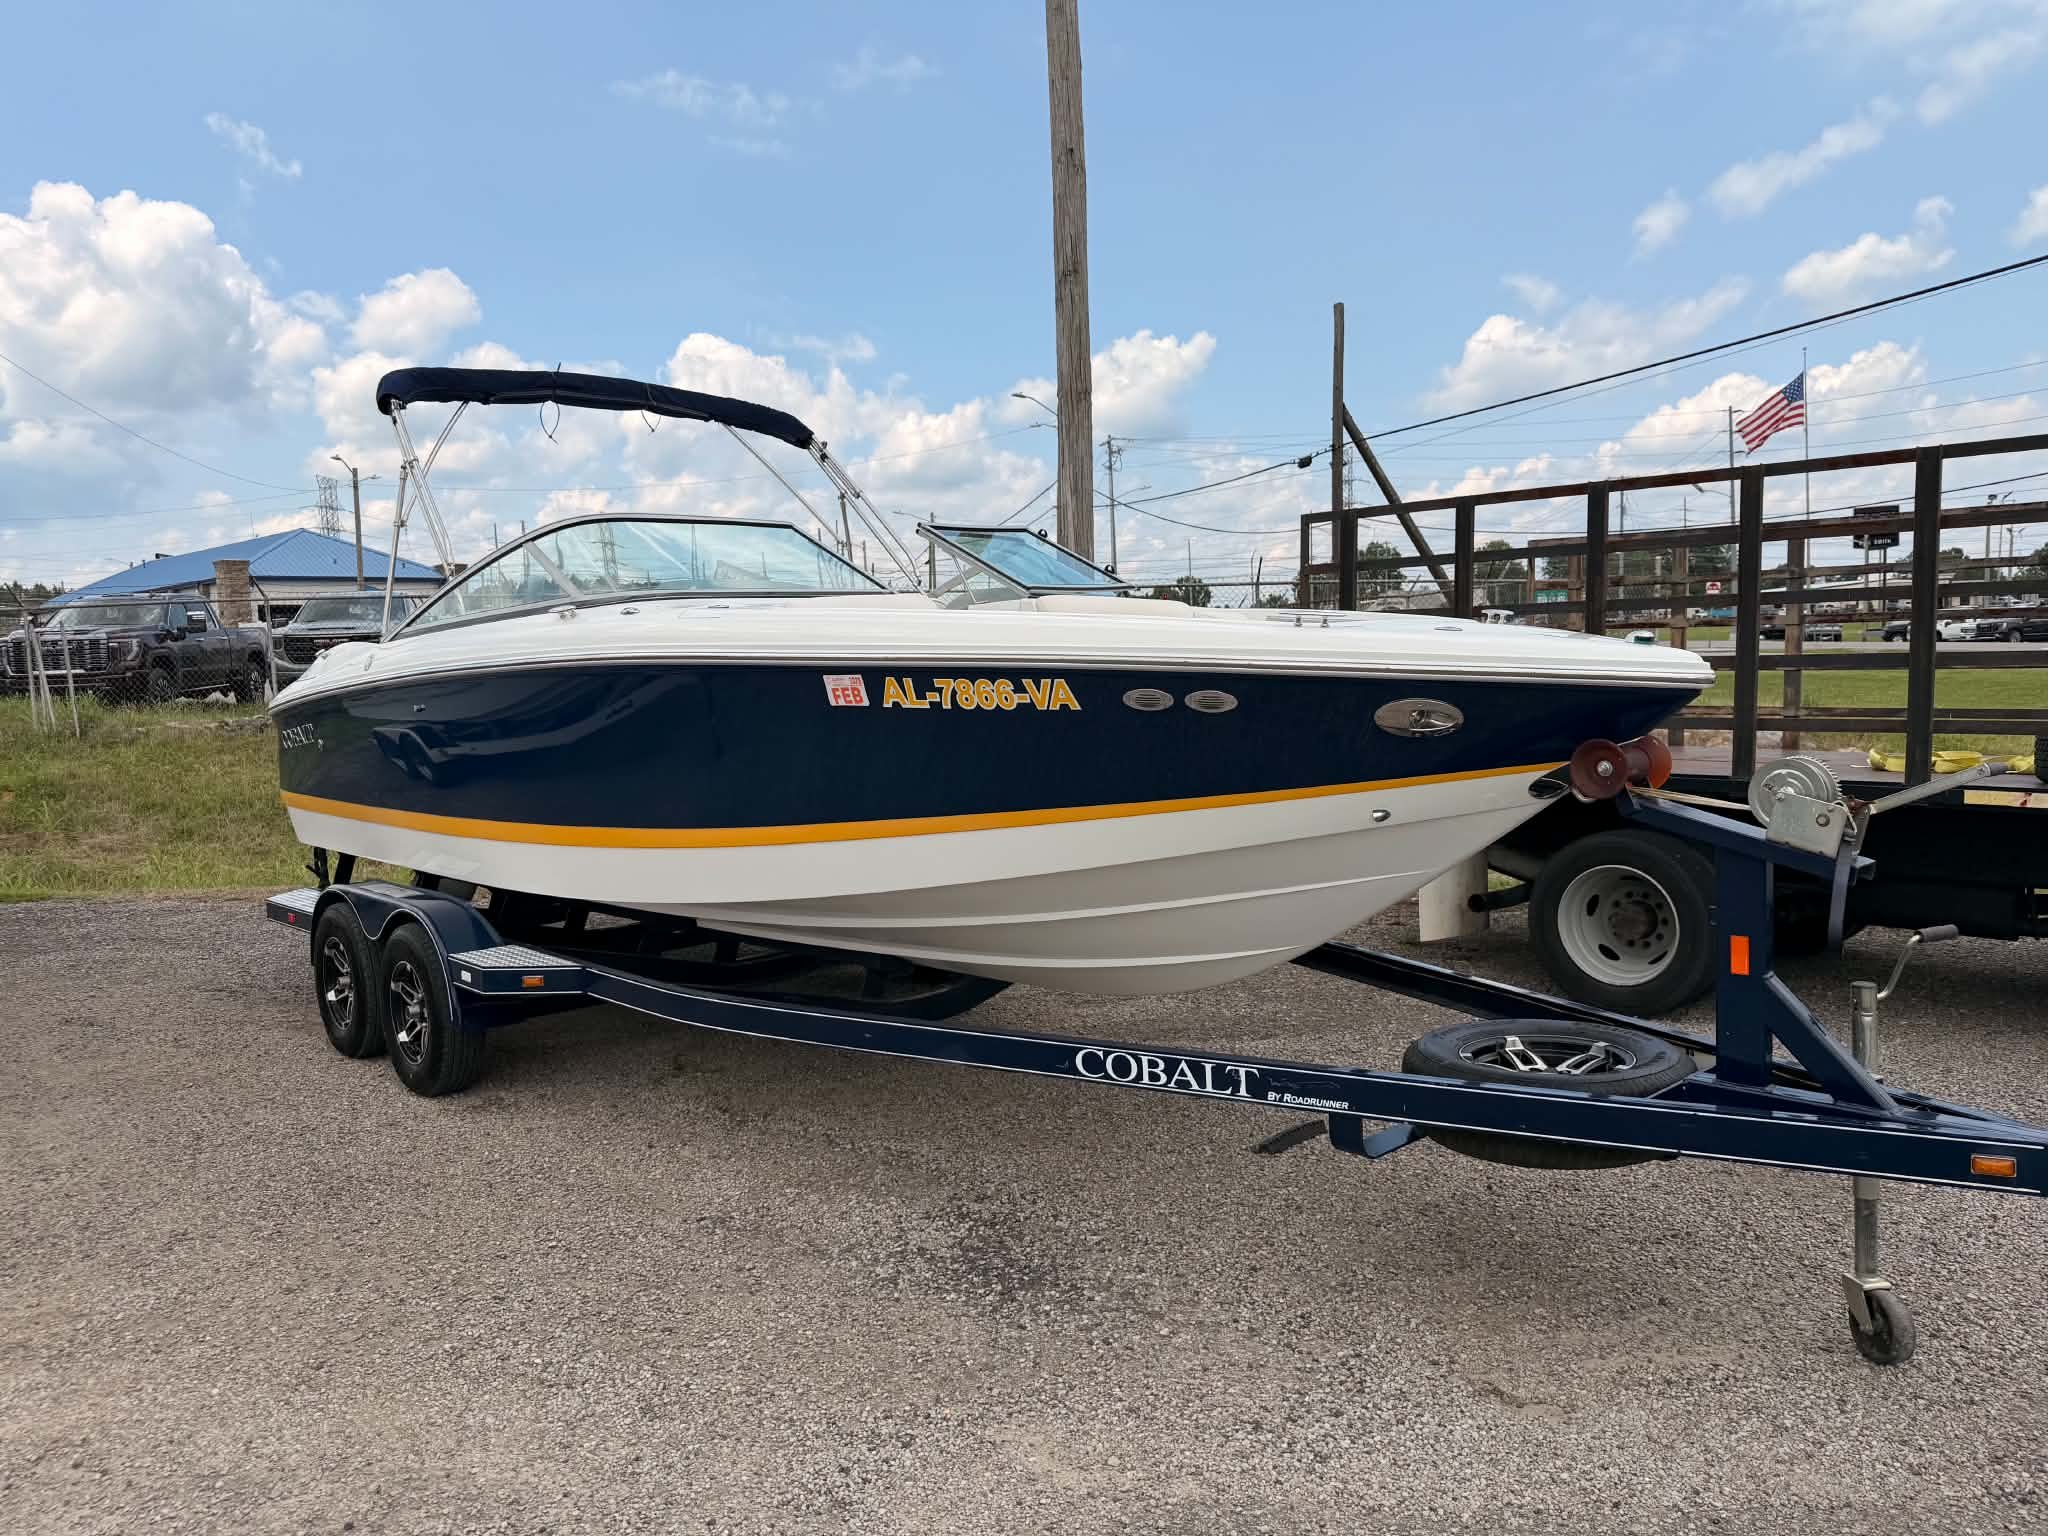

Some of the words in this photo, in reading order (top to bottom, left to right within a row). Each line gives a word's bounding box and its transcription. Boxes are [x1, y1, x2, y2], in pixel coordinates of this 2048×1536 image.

[831, 687, 865, 705] FEB
[882, 676, 1082, 711] AL-7866-VA
[1074, 1048, 1260, 1097] COBALT
